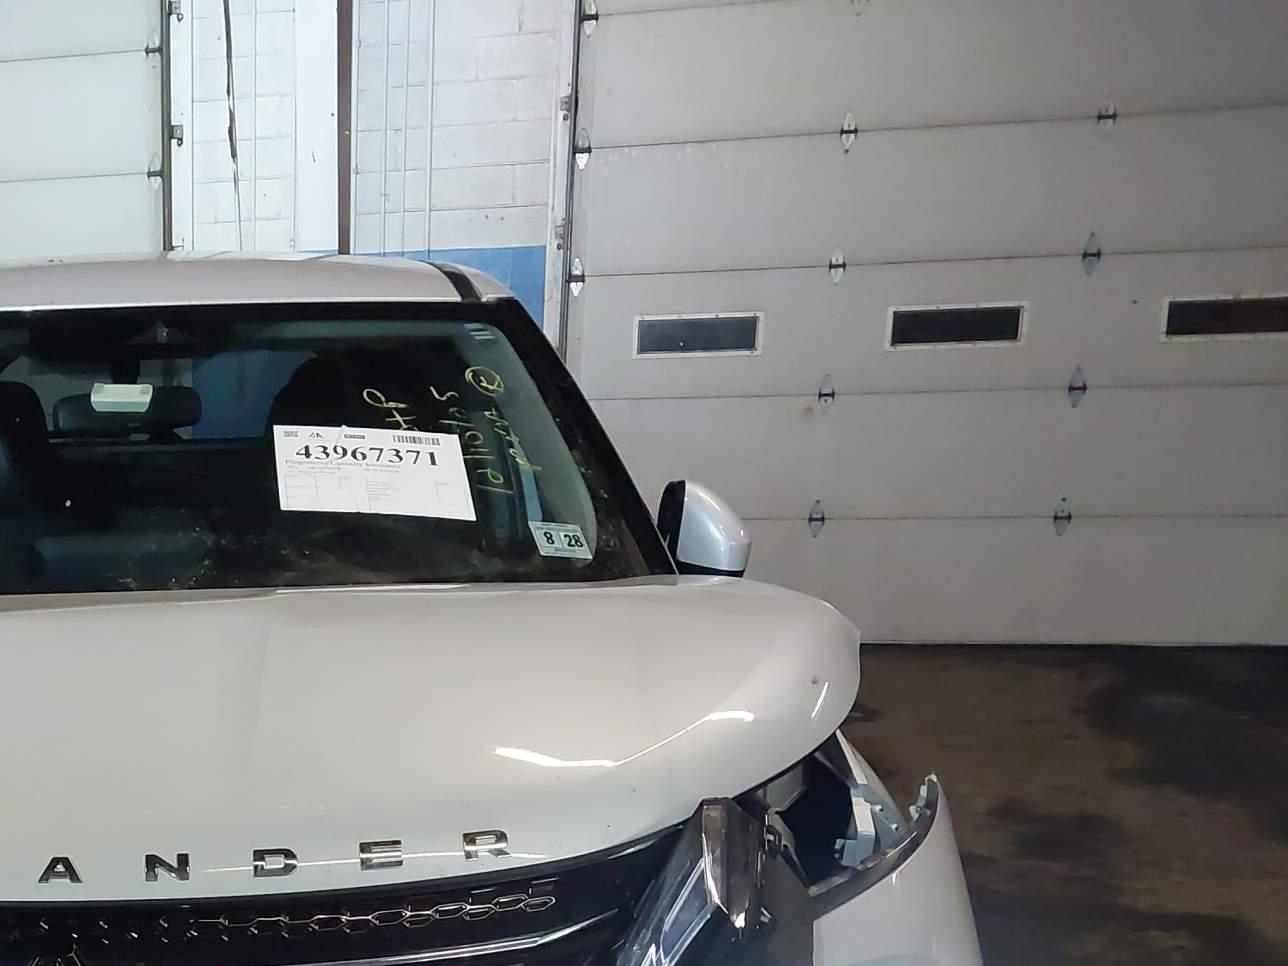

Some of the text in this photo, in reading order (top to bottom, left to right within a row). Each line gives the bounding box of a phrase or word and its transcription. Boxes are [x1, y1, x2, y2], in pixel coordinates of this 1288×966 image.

[296, 444, 440, 467] 43967371
[544, 531, 584, 548] 8 28
